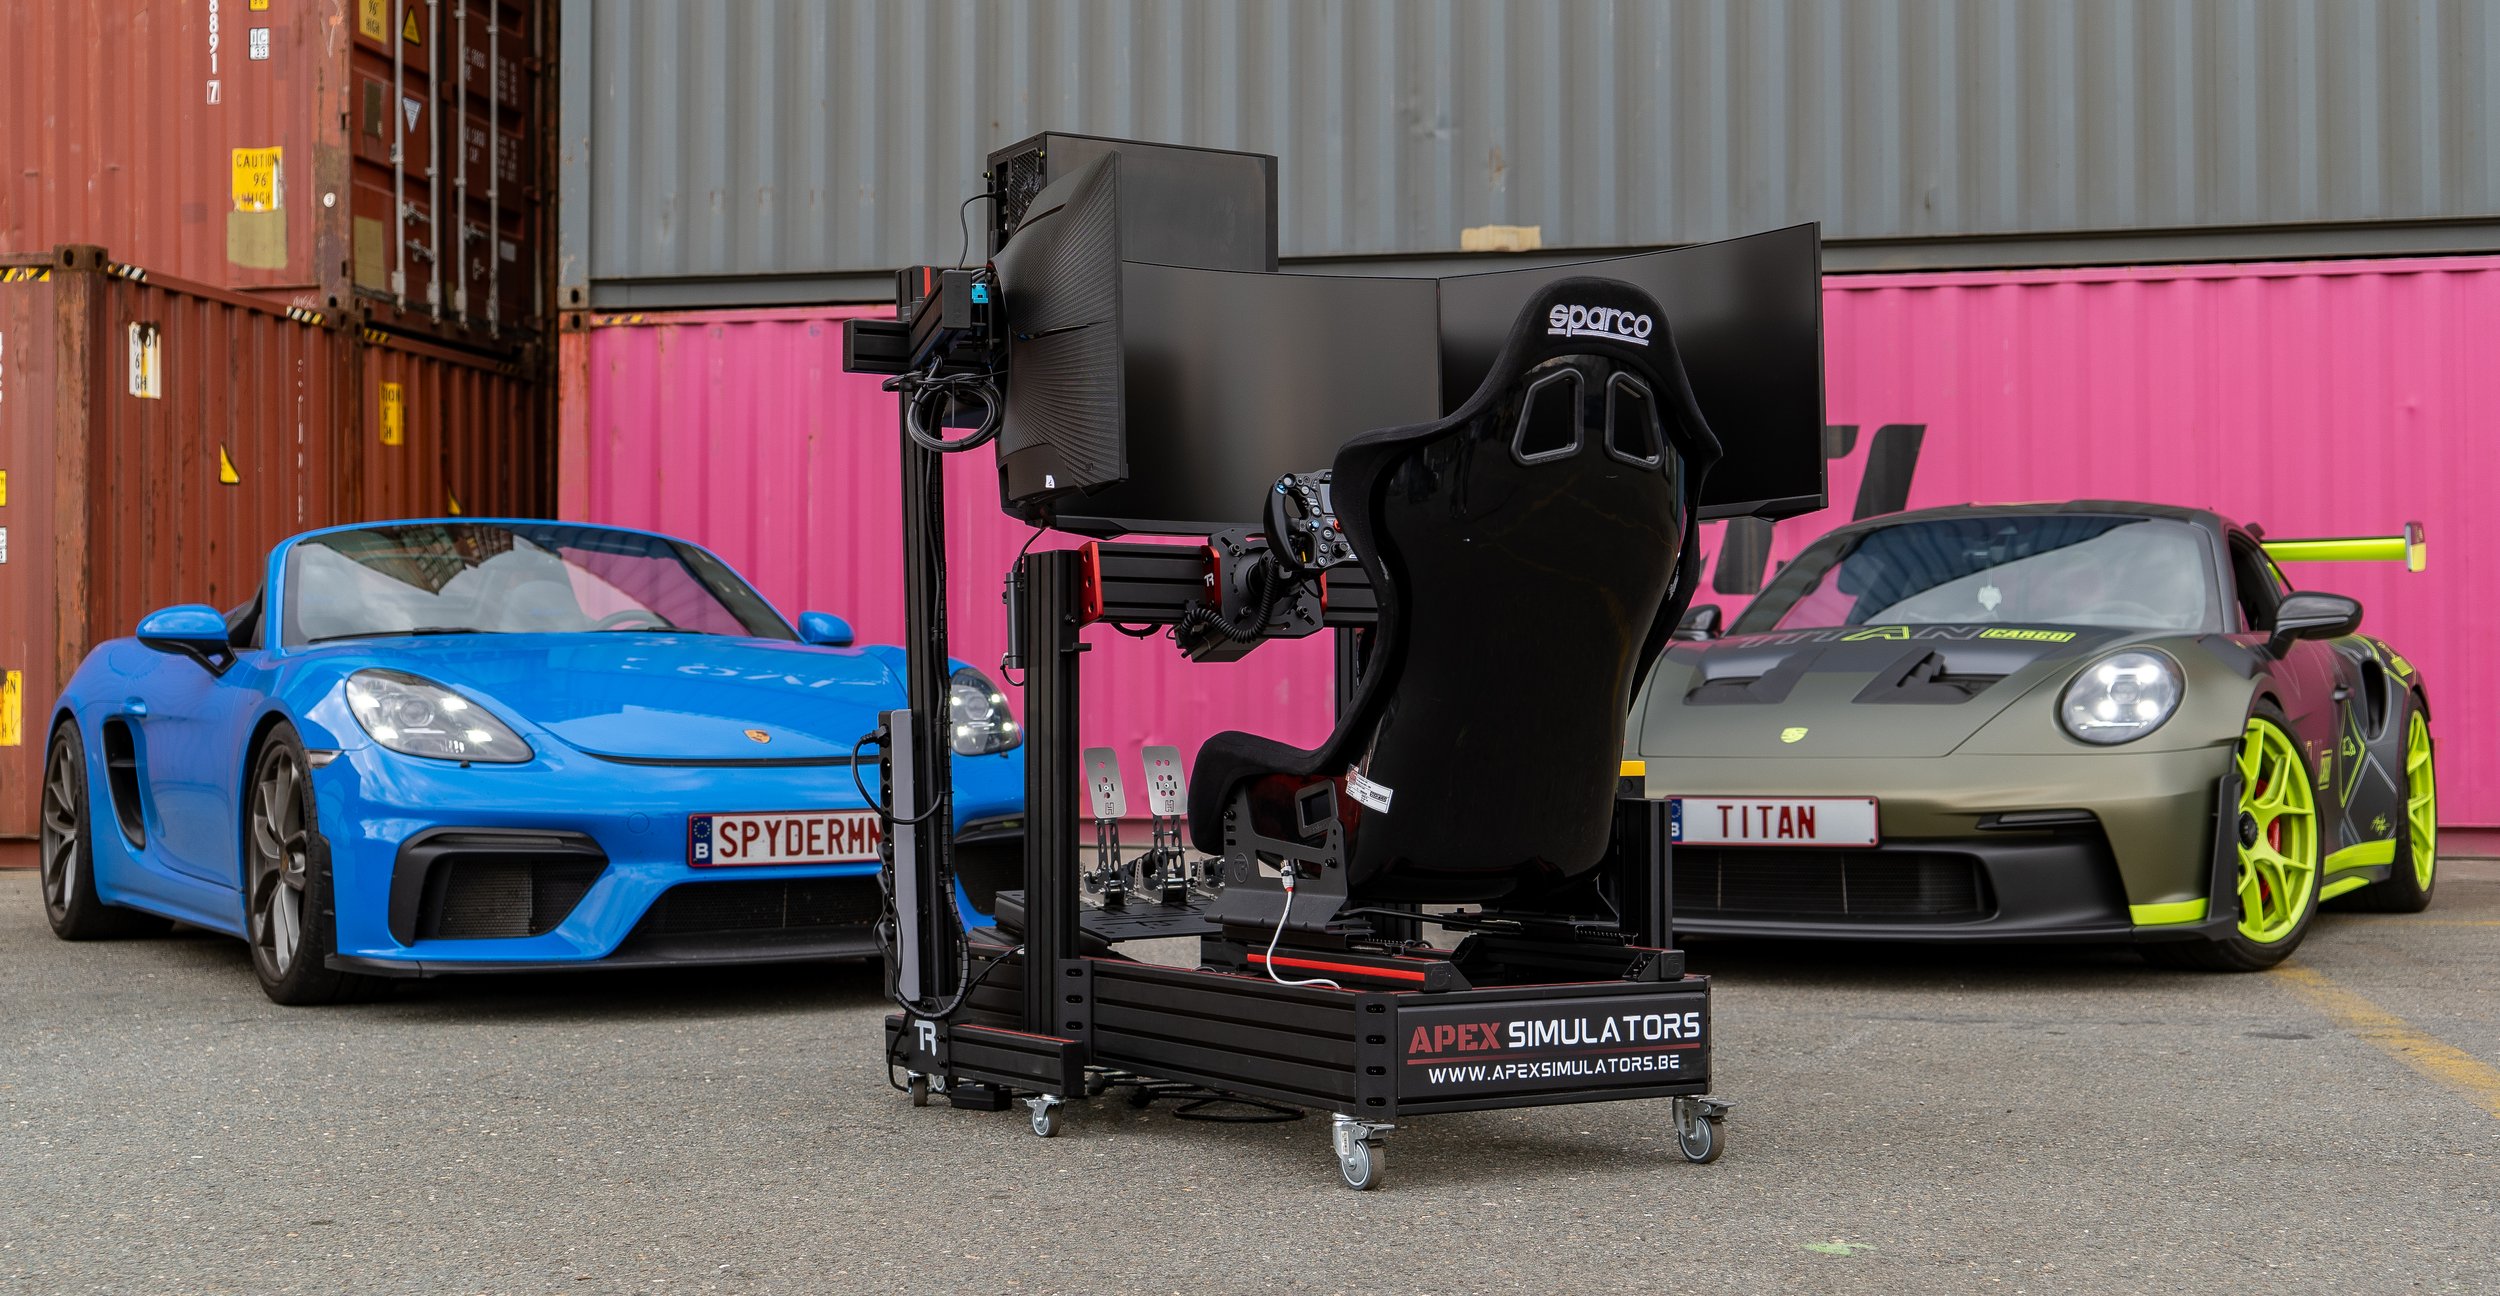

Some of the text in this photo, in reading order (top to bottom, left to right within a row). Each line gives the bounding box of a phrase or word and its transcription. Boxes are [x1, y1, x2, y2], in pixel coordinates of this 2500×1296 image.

[208, 81, 220, 104] 7
[236, 153, 279, 169] CAUTION
[1548, 304, 1653, 339] sparco
[719, 817, 882, 859] SPYDERMN
[1717, 805, 1816, 839] TITAN
[695, 843, 709, 859] B
[1408, 1012, 1700, 1054] APEX SIMULATORS
[1428, 1054, 1680, 1085] WWW.APEXSIMULATORS.BE
